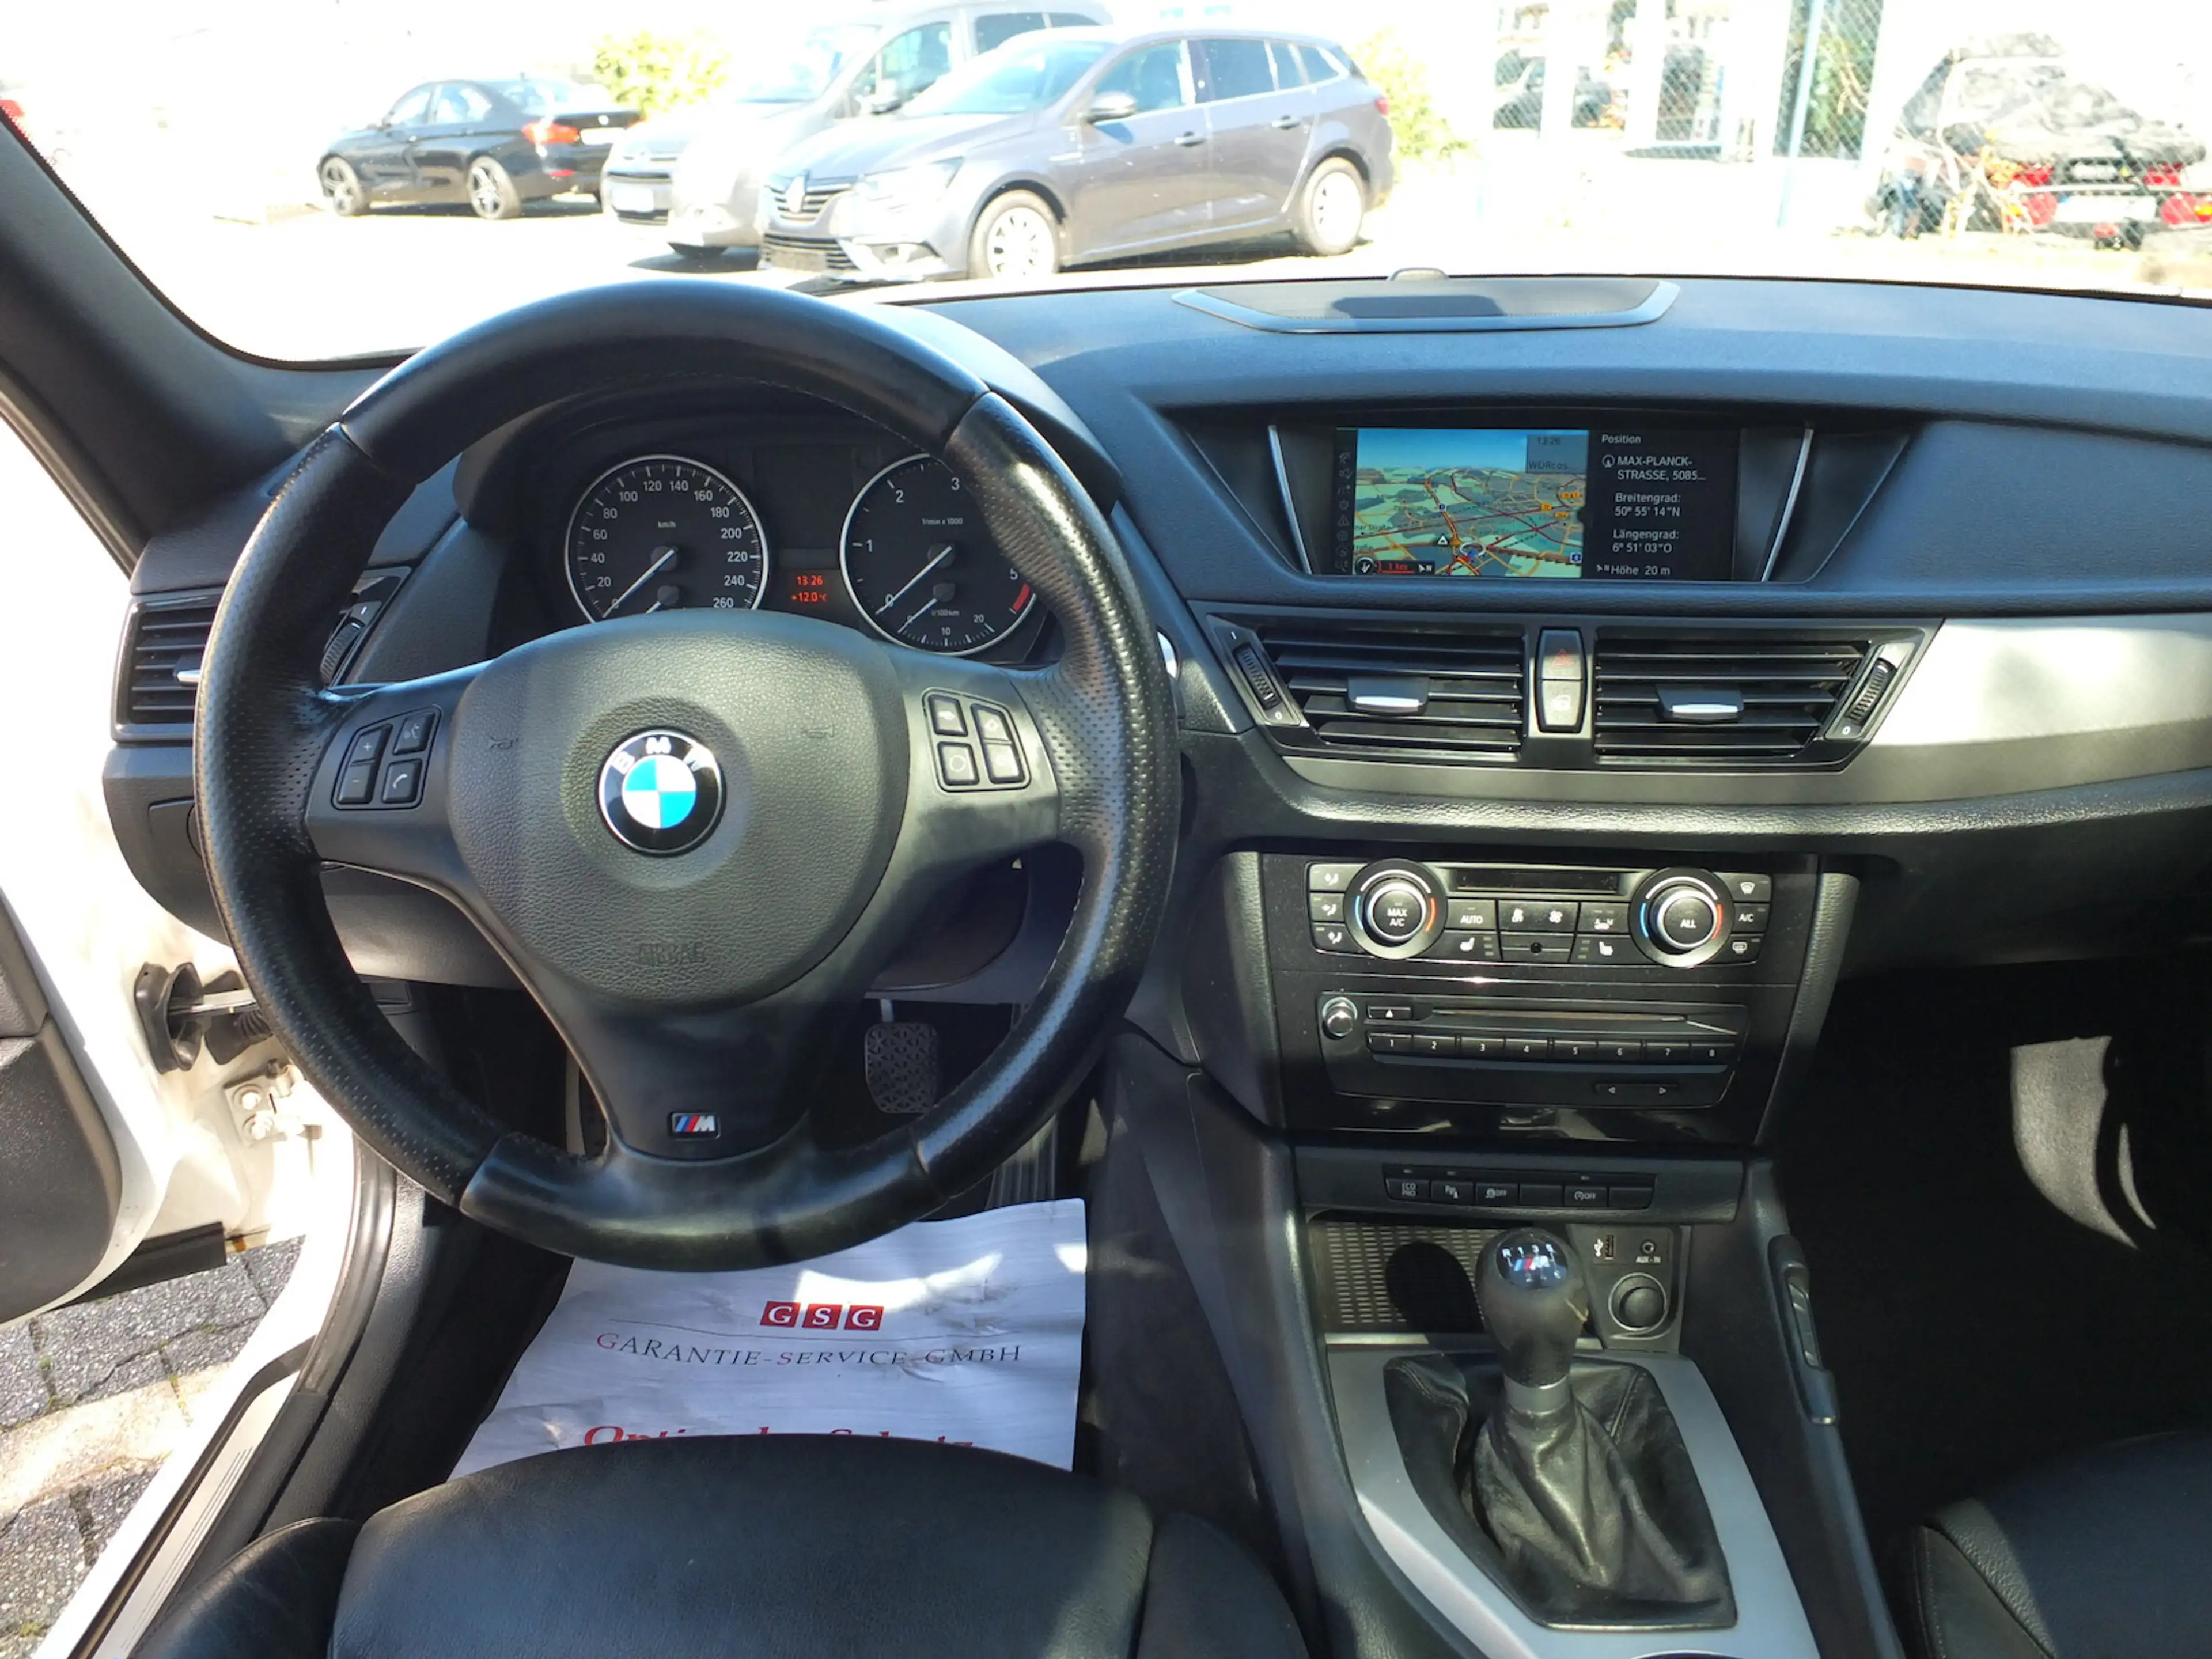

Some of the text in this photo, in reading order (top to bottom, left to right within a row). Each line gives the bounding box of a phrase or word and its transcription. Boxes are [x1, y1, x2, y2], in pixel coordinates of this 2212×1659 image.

[1601, 434, 1642, 444] Position
[1617, 456, 1692, 466] MAX-PLANCK-
[1617, 469, 1669, 482] STRASSE,
[643, 480, 662, 491] 120
[670, 480, 689, 491] 140
[950, 477, 960, 491] 3
[619, 491, 638, 502] 100
[694, 490, 713, 502] 160
[895, 489, 904, 503] 2
[1615, 492, 1681, 505] Breitengrad:
[603, 507, 618, 518] 80
[710, 507, 729, 518] 180
[593, 529, 608, 540] 60
[721, 528, 742, 539] 200
[1612, 528, 1680, 541] Längengrad:
[866, 539, 873, 552] 1
[590, 552, 605, 563] 40
[726, 551, 748, 562] 220
[1010, 568, 1018, 581] 5
[1611, 565, 1671, 575] Höhe 20 m
[597, 577, 612, 588] 20
[724, 575, 745, 586] 240
[713, 597, 734, 608] 260
[973, 614, 985, 623] 20
[941, 627, 951, 636] 10
[611, 736, 716, 775] BMW
[1387, 908, 1407, 918] MAX
[1738, 913, 1754, 922] A/C
[1389, 918, 1405, 927] A/C
[1460, 915, 1483, 924] AUTO
[1680, 919, 1696, 929] ALL
[1431, 1040, 1437, 1051] 2
[1480, 1043, 1486, 1052] 3
[1523, 1044, 1530, 1053] 4
[1572, 1046, 1579, 1055] 5
[1616, 1047, 1623, 1056] 6
[1665, 1047, 1671, 1056] 7
[768, 1305, 876, 1328] GSG
[596, 1332, 1021, 1365] GARANTIE-SERVICE GMBH
